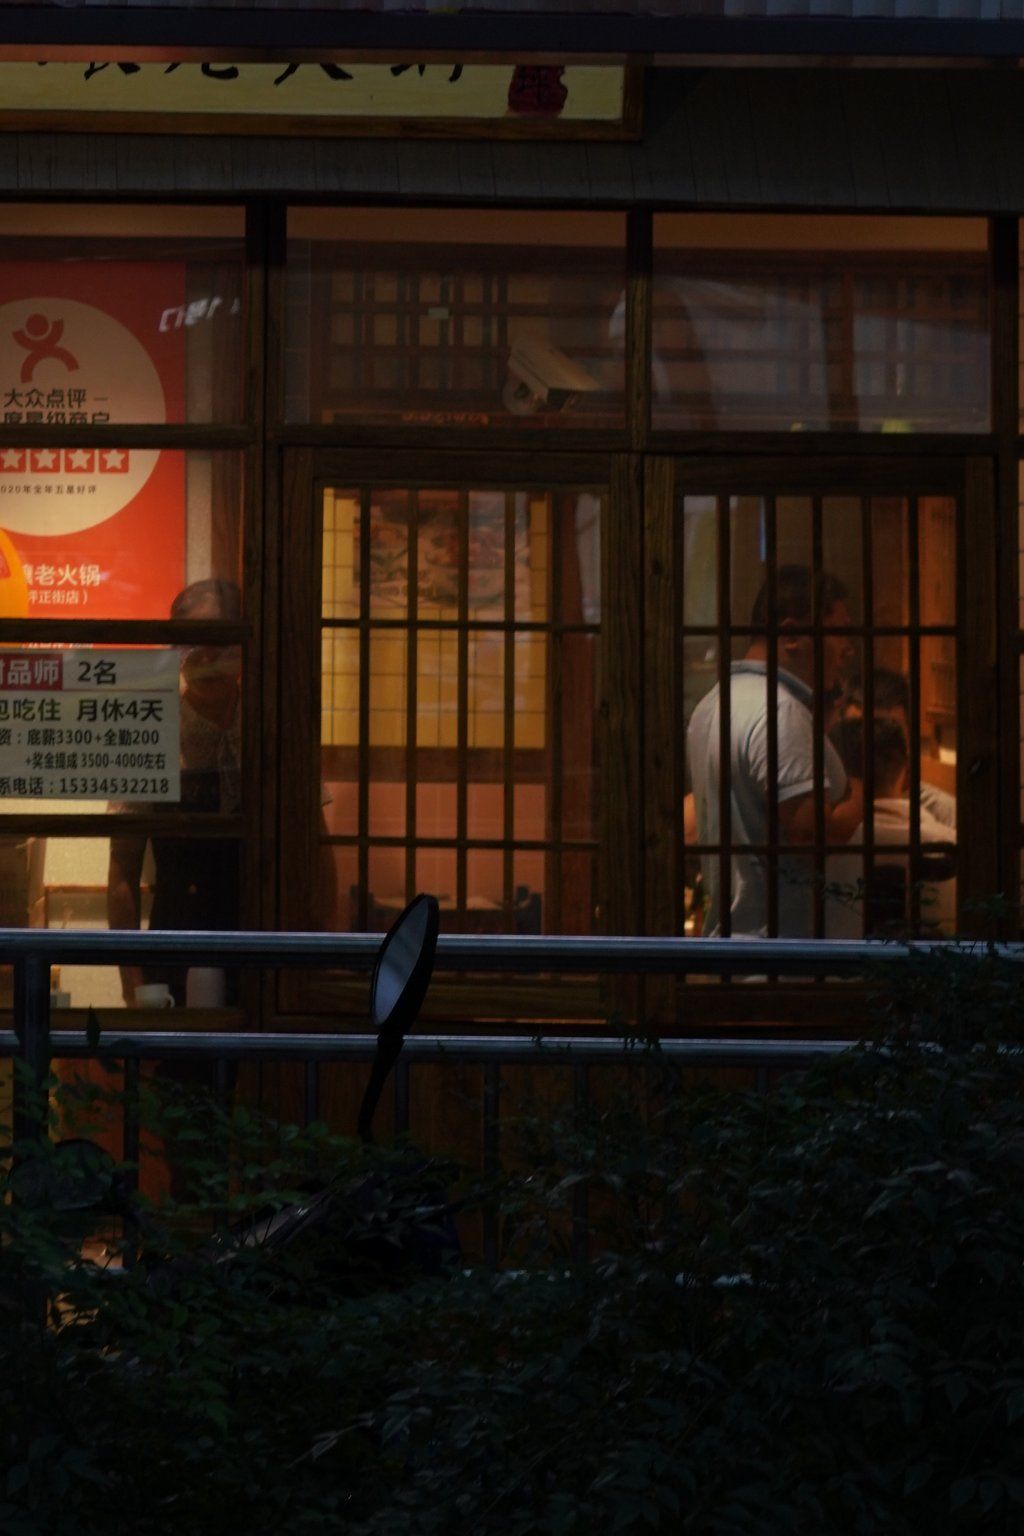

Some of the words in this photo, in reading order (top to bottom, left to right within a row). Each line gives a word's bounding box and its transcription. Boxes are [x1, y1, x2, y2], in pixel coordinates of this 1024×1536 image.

[3, 388, 87, 408] 大众点评
[77, 659, 117, 685] 2名
[77, 699, 164, 722] 月休4天
